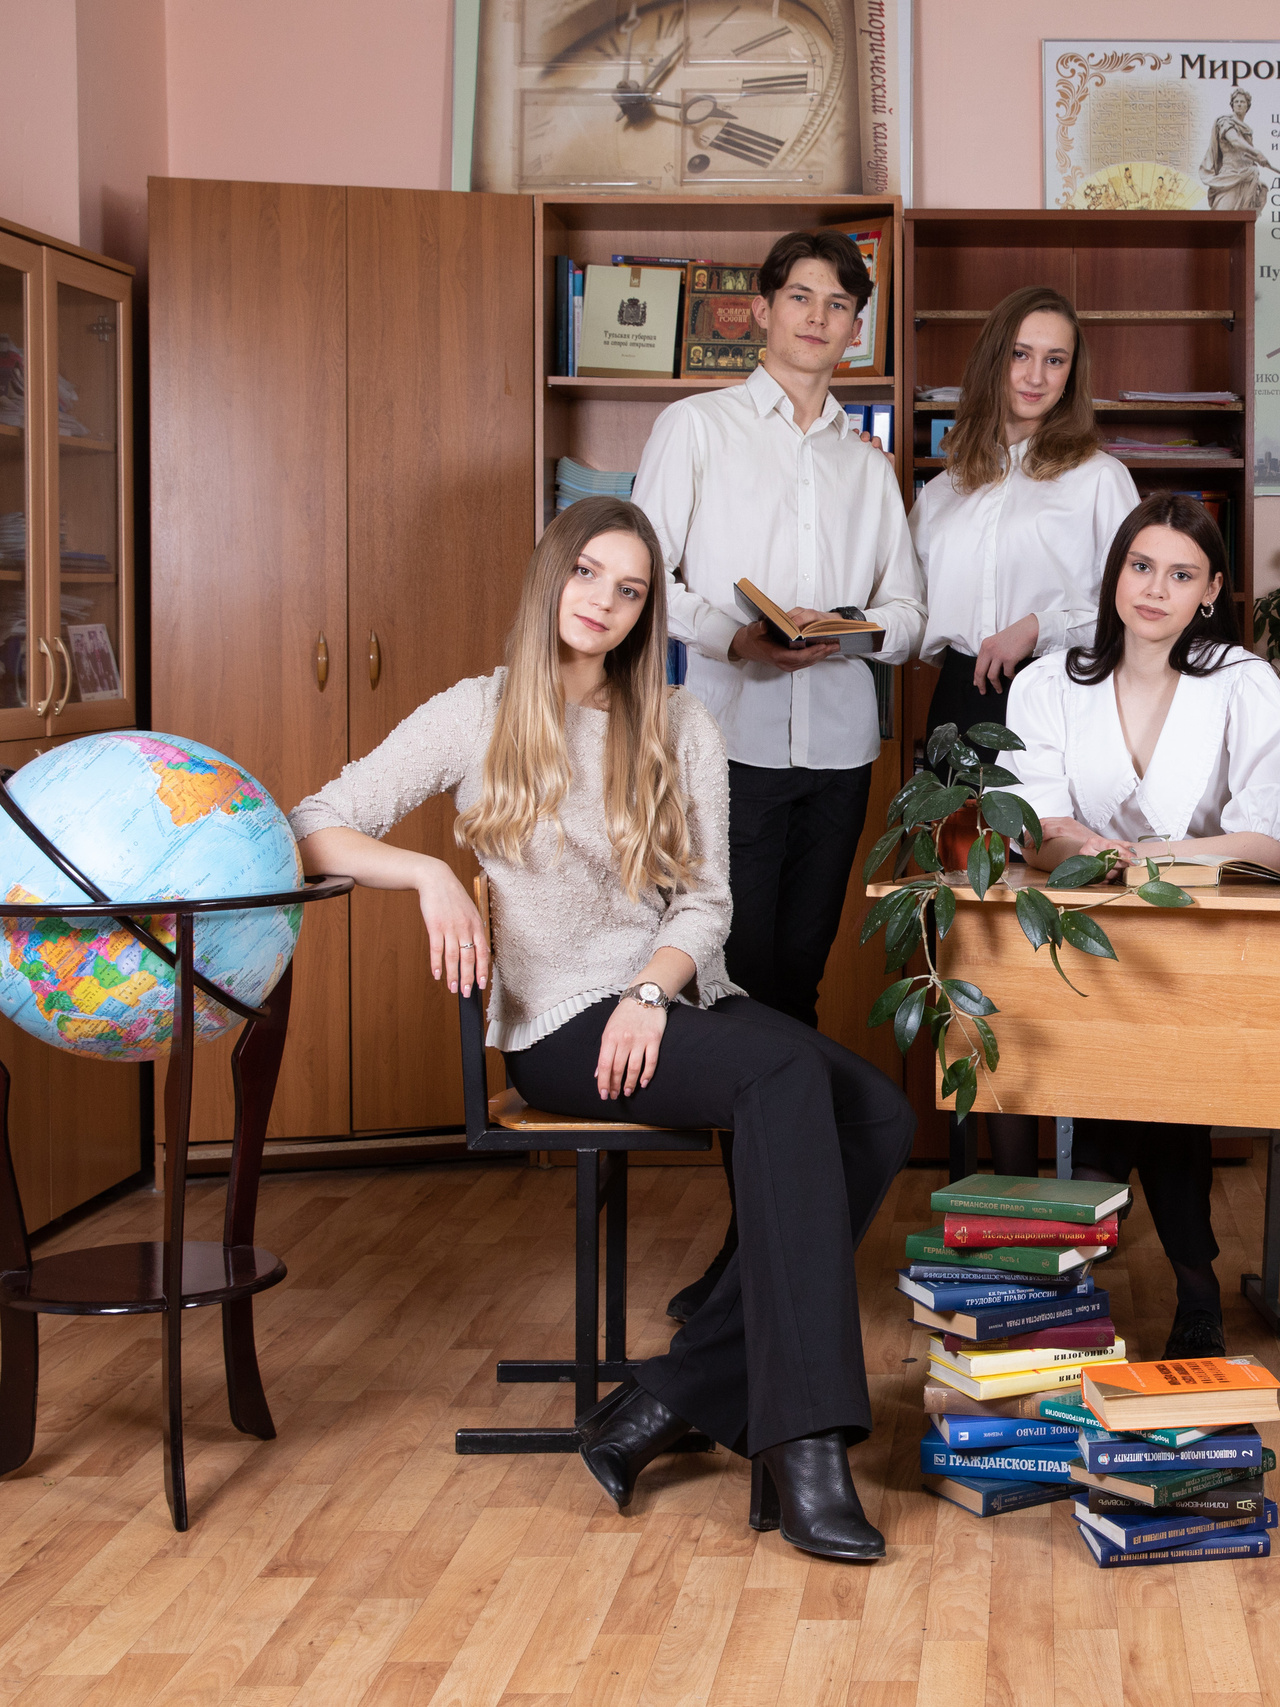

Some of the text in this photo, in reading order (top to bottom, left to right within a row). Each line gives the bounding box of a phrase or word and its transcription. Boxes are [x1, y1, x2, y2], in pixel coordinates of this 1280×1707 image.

[860, 0, 893, 192] торический календарь
[1271, 142, 1279, 151] и
[603, 330, 657, 341] Тульская губерния
[950, 1199, 998, 1211] ГЕРМАНСКОЕ
[1000, 1204, 1025, 1213] ПРАВО
[981, 1229, 1086, 1241] Международное право
[923, 1246, 965, 1260] ГЕРМАНСКОЕ
[966, 1250, 993, 1262] ПРАВО
[965, 1290, 1057, 1306] ТРУДОВОЕ ПРАВО РОССИИ
[1026, 1311, 1055, 1324] ГОСУДАРСТВА
[1056, 1308, 1073, 1318] ТЕОРИЯ
[1006, 1317, 1021, 1327] ПРАВА
[1045, 1408, 1086, 1424] АНТРОПОЛОГИЯ
[1016, 1427, 1046, 1437] ПРАВО
[1147, 1433, 1170, 1444] Норбер
[1113, 1452, 1144, 1463] ЛИТЕРАТУР
[1144, 1451, 1175, 1462] ОБЩНОСТЬ
[1180, 1450, 1206, 1461] НАРОДОВ
[1206, 1449, 1237, 1460] ОБЩНОСТЬ
[949, 1454, 1036, 1471] ГРАЖДАНСКОЕ
[1098, 1498, 1131, 1507] СЛОВАРЬ
[1175, 1500, 1229, 1509] ПОЛИТИЧЕСКАЯ
[1133, 1535, 1142, 1545] ДЕЛ
[1109, 1555, 1119, 1563] ДЕЛ
[1149, 1551, 1169, 1560] ОРГАНОВ
[1170, 1549, 1203, 1559] ДЕЯТЕЛЬНОСТЬ
